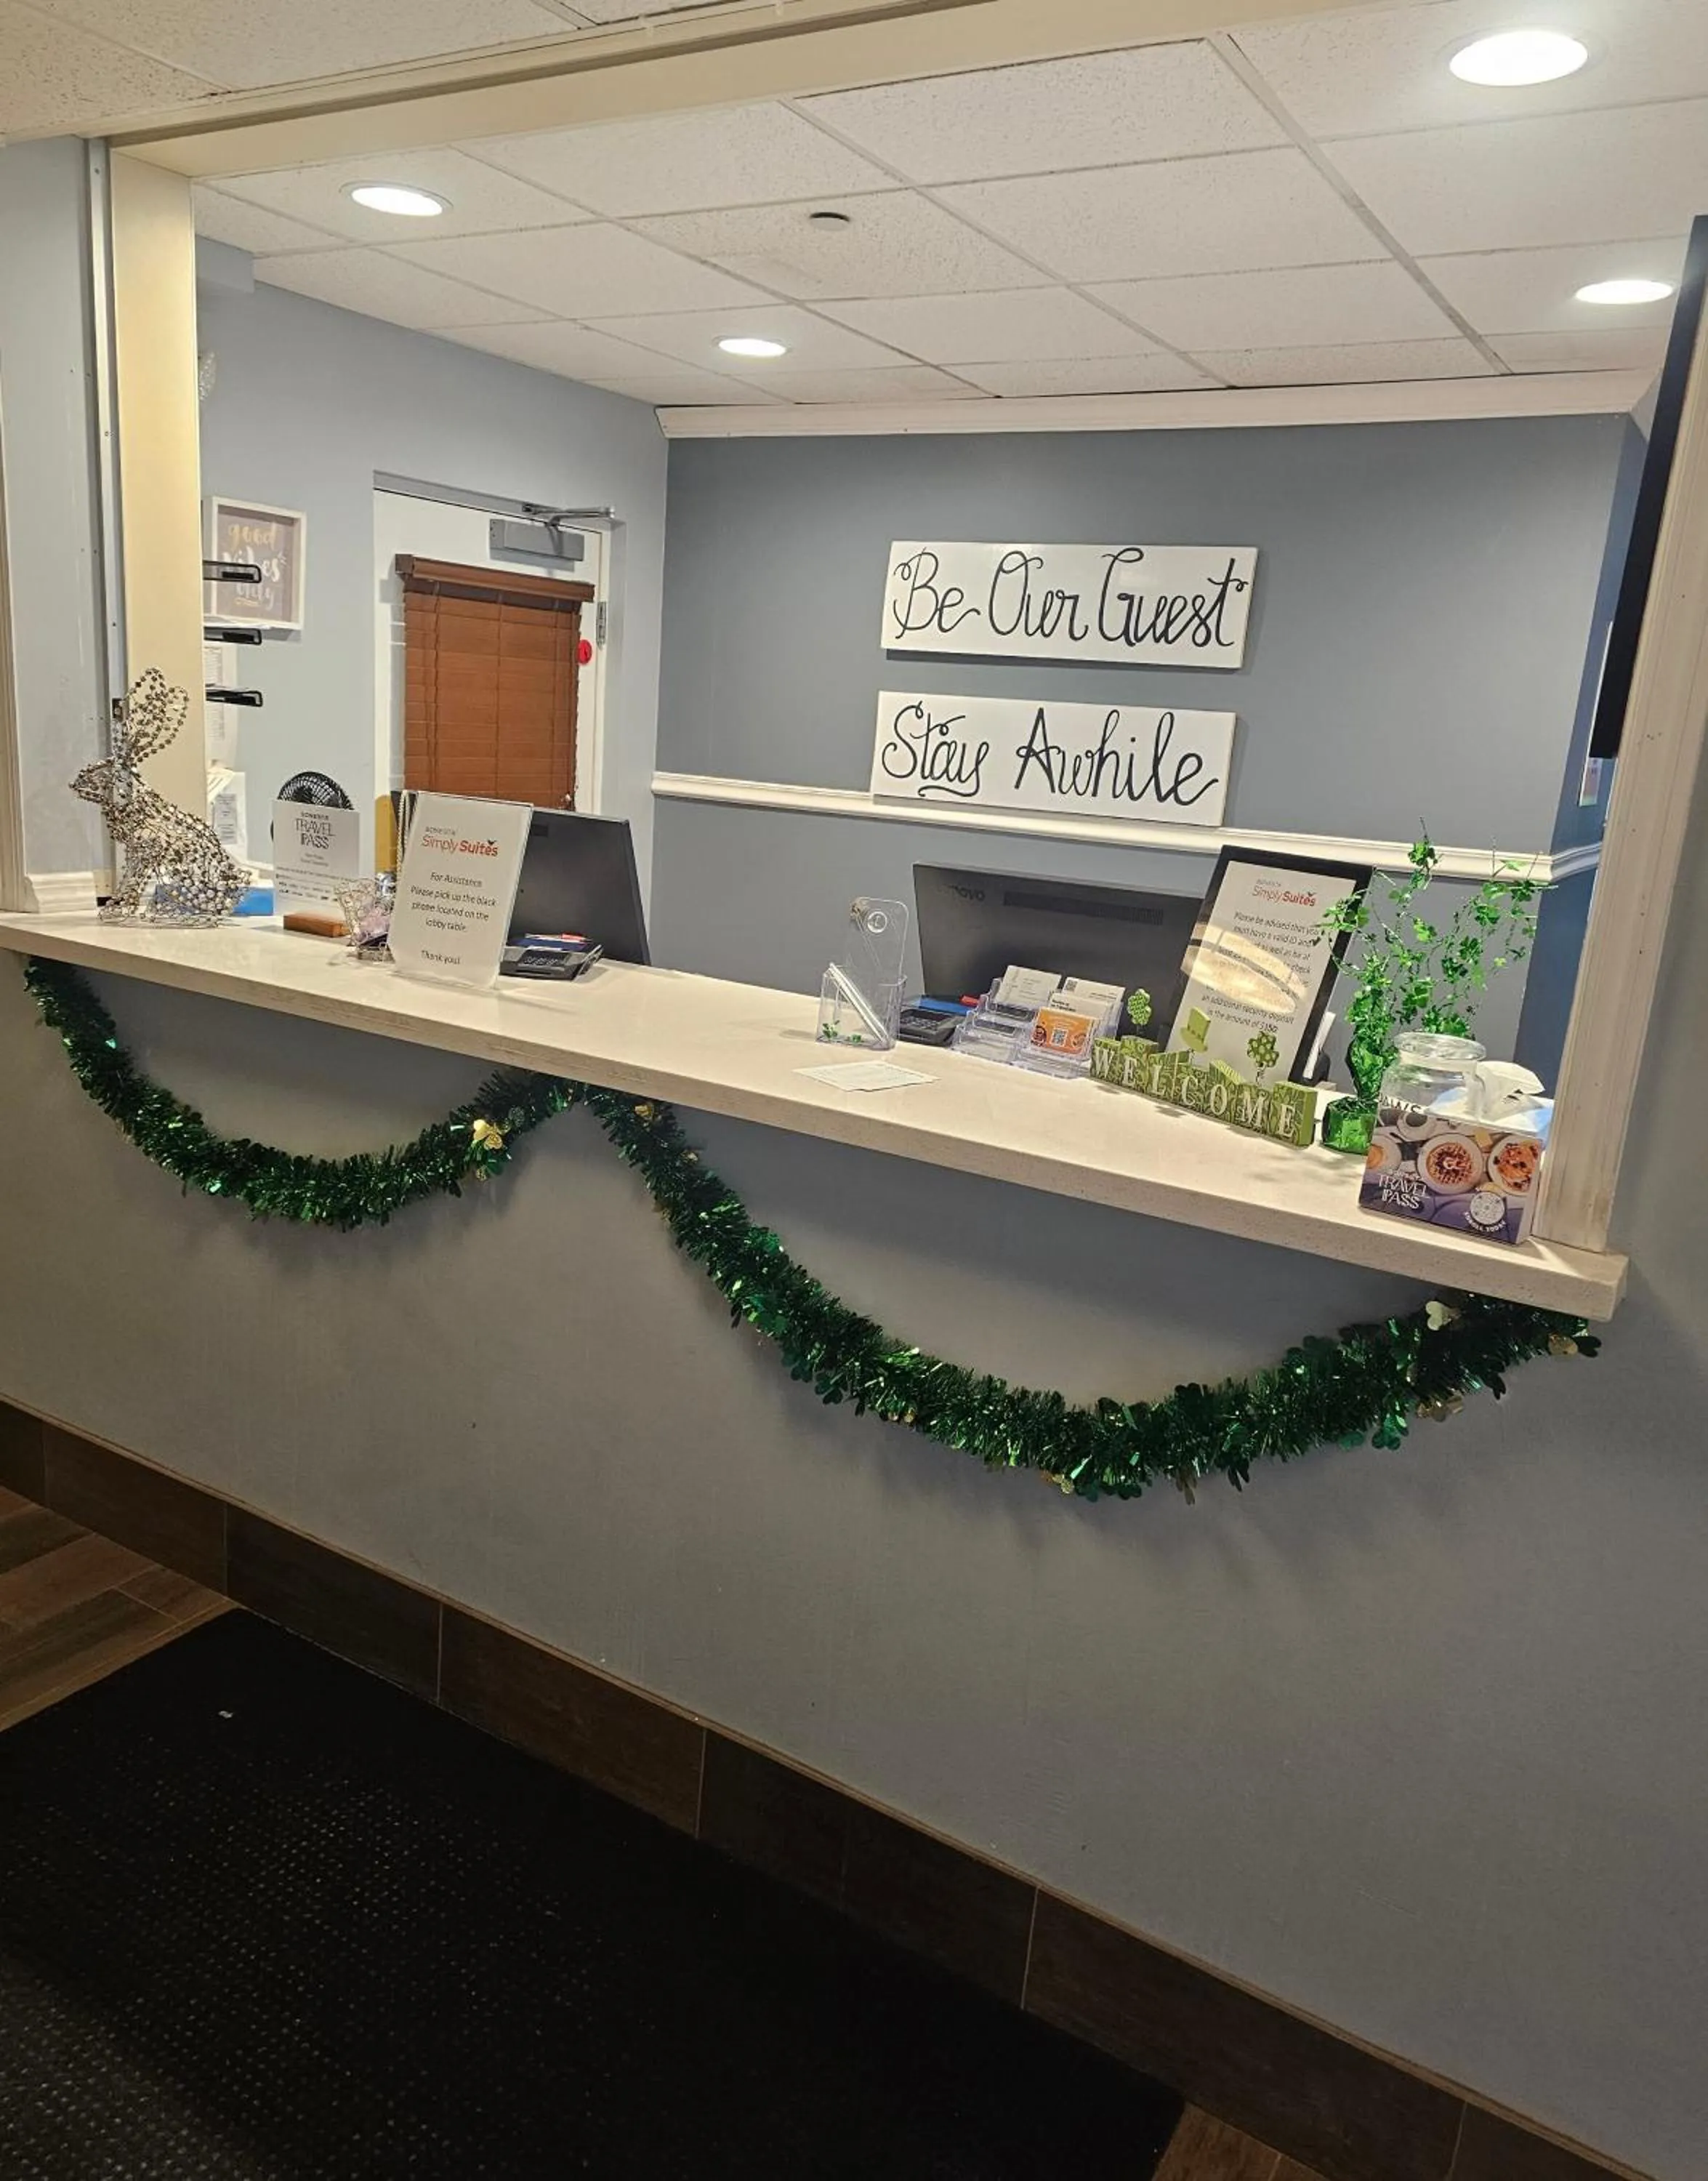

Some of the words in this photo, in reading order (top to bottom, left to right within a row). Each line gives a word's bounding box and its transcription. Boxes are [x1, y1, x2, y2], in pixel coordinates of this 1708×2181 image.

[228, 521, 278, 551] good
[893, 547, 980, 639] Be
[988, 550, 1089, 640] Our
[1098, 547, 1249, 648] Guest
[882, 699, 990, 798] Stay
[1014, 706, 1219, 807] Awhile
[296, 818, 337, 836] TRAVEL
[301, 832, 329, 849] PASS
[422, 835, 459, 854] Simply
[459, 839, 499, 857] Suites
[430, 872, 443, 882] For
[411, 885, 434, 897] Please
[435, 889, 451, 901] pick
[463, 894, 475, 904] the
[477, 897, 496, 907] black
[1252, 885, 1283, 904] Simply
[1282, 891, 1316, 907] Suites
[411, 901, 435, 912] phone
[437, 905, 464, 916] located
[476, 911, 489, 920] the
[1233, 911, 1254, 923] Please
[1255, 914, 1264, 923] be
[1265, 917, 1290, 930] advised
[426, 918, 446, 931] lobby
[1250, 926, 1266, 939] have
[1273, 933, 1289, 944] valid
[421, 950, 443, 961] Thank
[1094, 1045, 1297, 1138] WELCOME
[1377, 1173, 1430, 1199] TRAVEL
[1381, 1189, 1419, 1209] PASS
